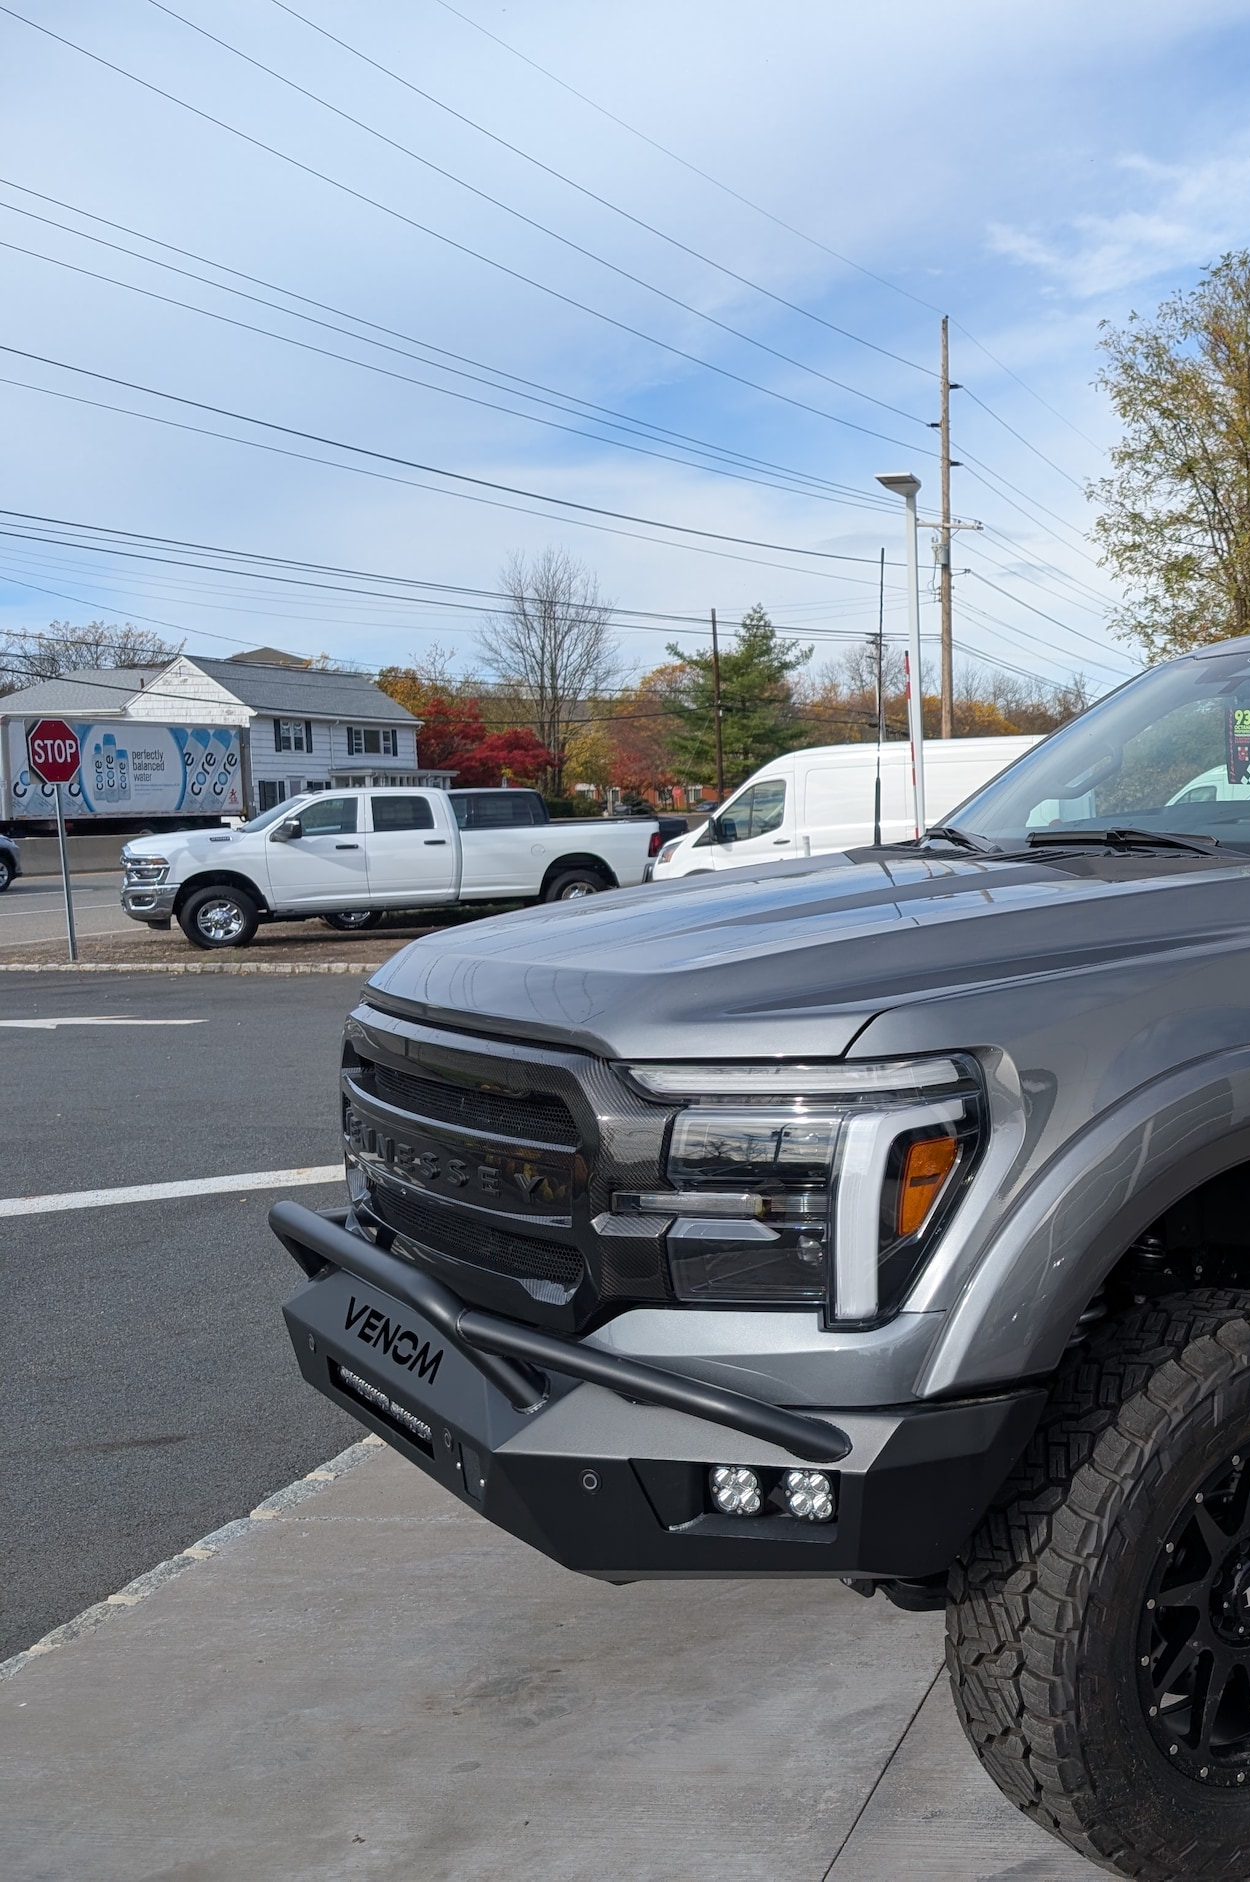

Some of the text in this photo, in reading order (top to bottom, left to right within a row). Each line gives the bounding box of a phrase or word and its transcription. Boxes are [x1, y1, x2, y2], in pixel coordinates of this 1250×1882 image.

[34, 739, 76, 763] STOP
[132, 749, 164, 763] perfectly
[95, 760, 104, 790] core
[105, 754, 115, 788] core
[119, 762, 127, 789] core
[132, 761, 165, 771] balanced
[133, 773, 152, 782] water
[191, 752, 216, 796] core
[213, 752, 238, 796] core
[344, 1296, 444, 1386] VENOM
